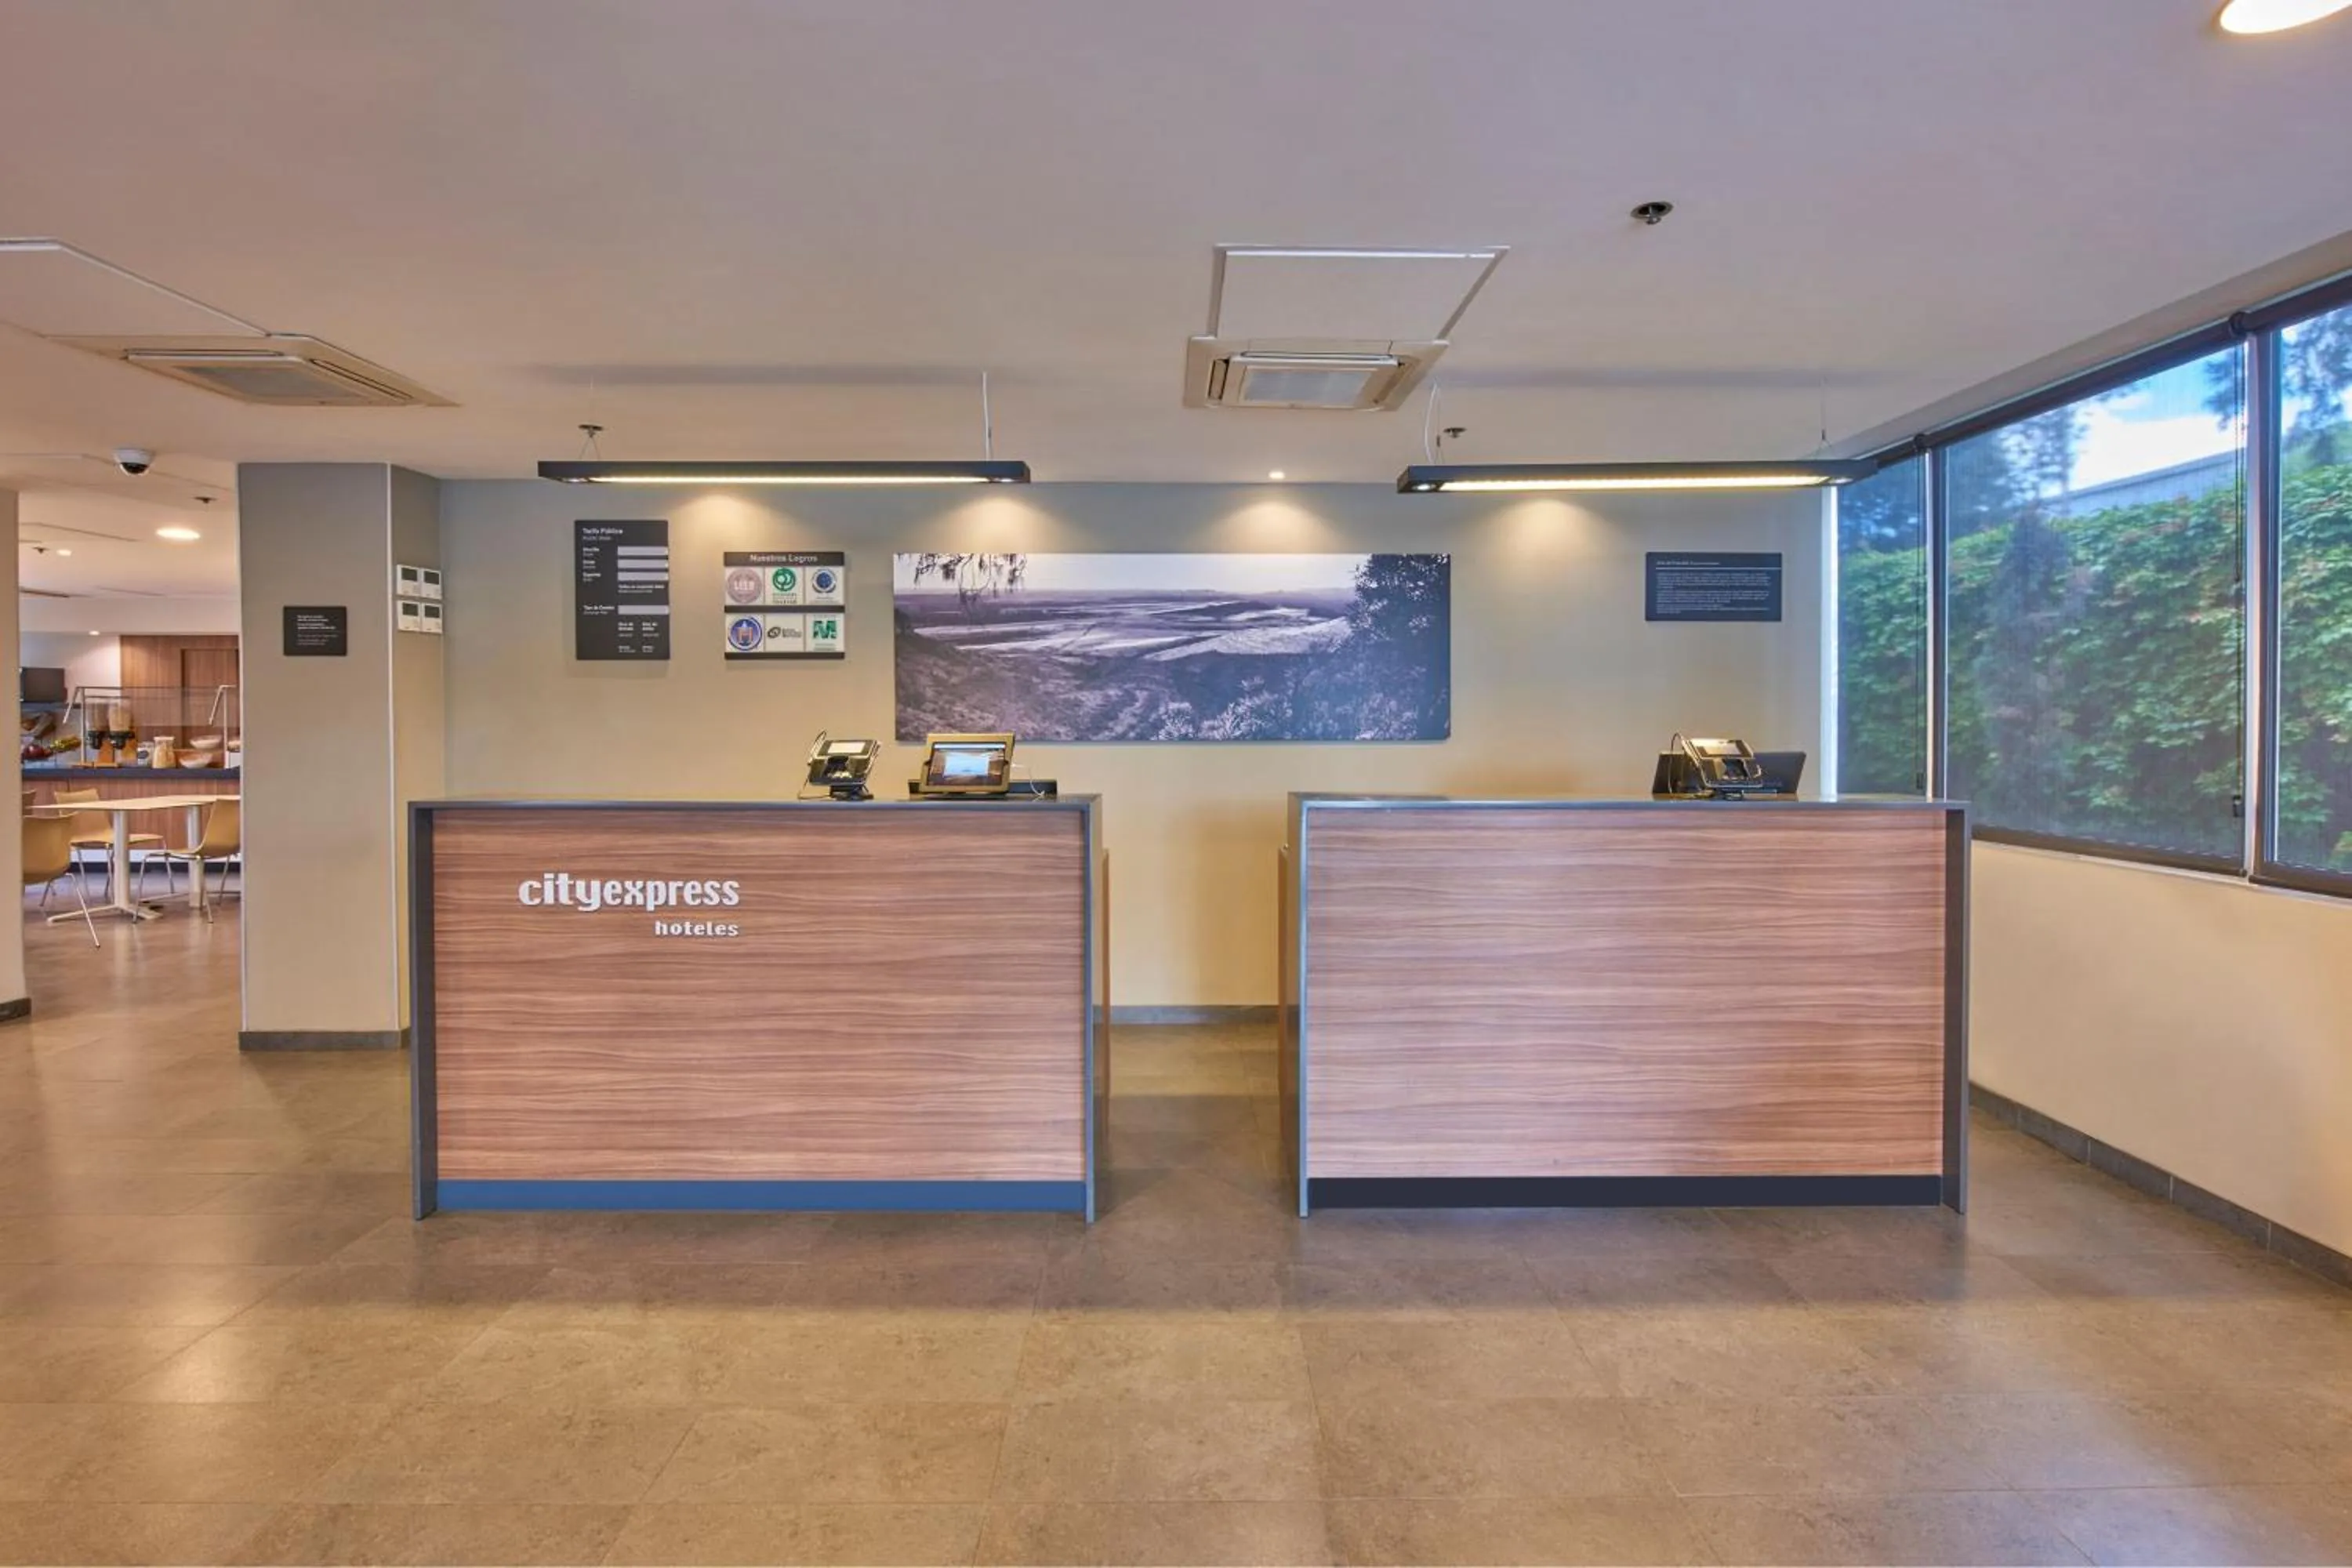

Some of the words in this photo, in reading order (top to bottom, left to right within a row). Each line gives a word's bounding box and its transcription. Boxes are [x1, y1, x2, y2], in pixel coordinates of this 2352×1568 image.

[788, 554, 818, 564] Logros
[518, 873, 740, 912] cityexpress
[655, 920, 739, 936] hoteles
